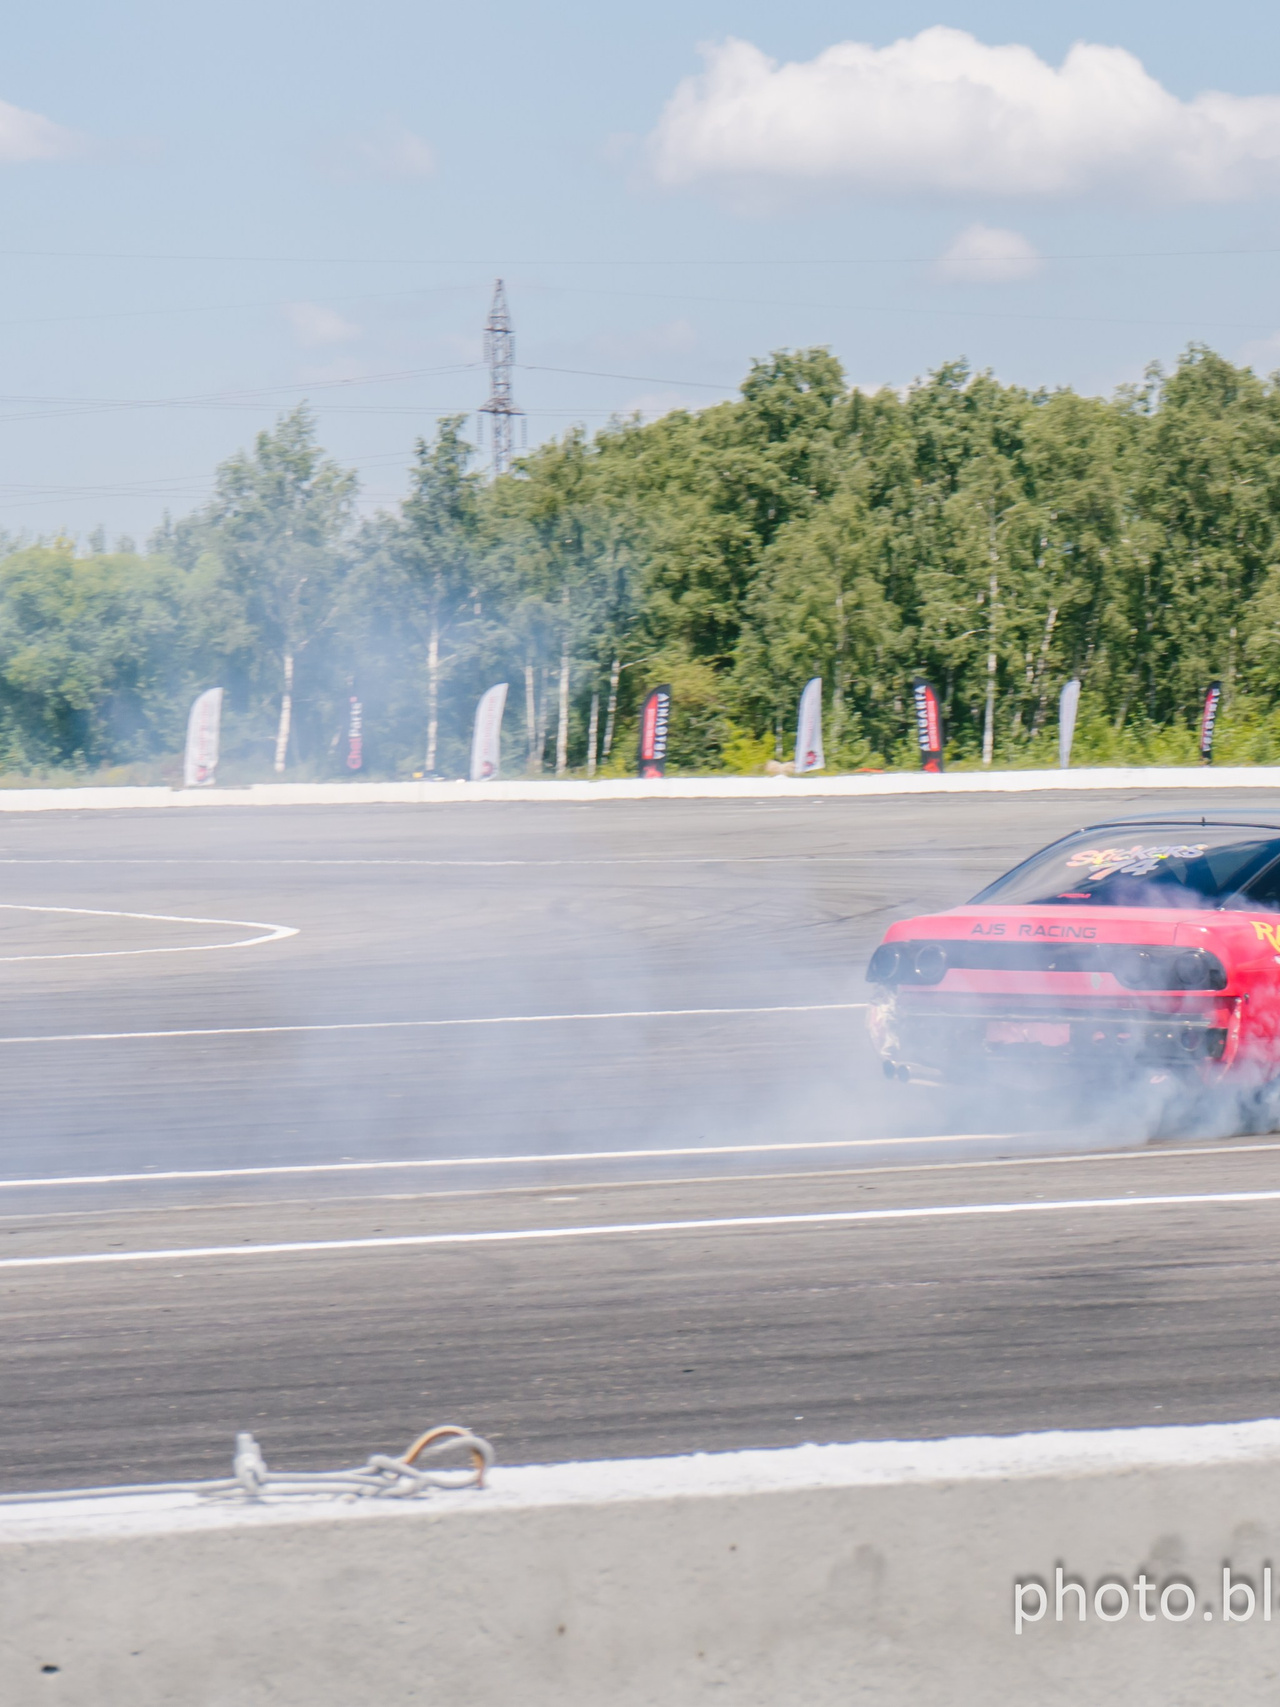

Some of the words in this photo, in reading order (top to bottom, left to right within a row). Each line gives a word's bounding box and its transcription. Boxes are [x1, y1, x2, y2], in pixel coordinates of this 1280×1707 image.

[1088, 859, 1160, 880] 74
[971, 923, 1006, 935] AJS
[1019, 924, 1097, 939] RACING
